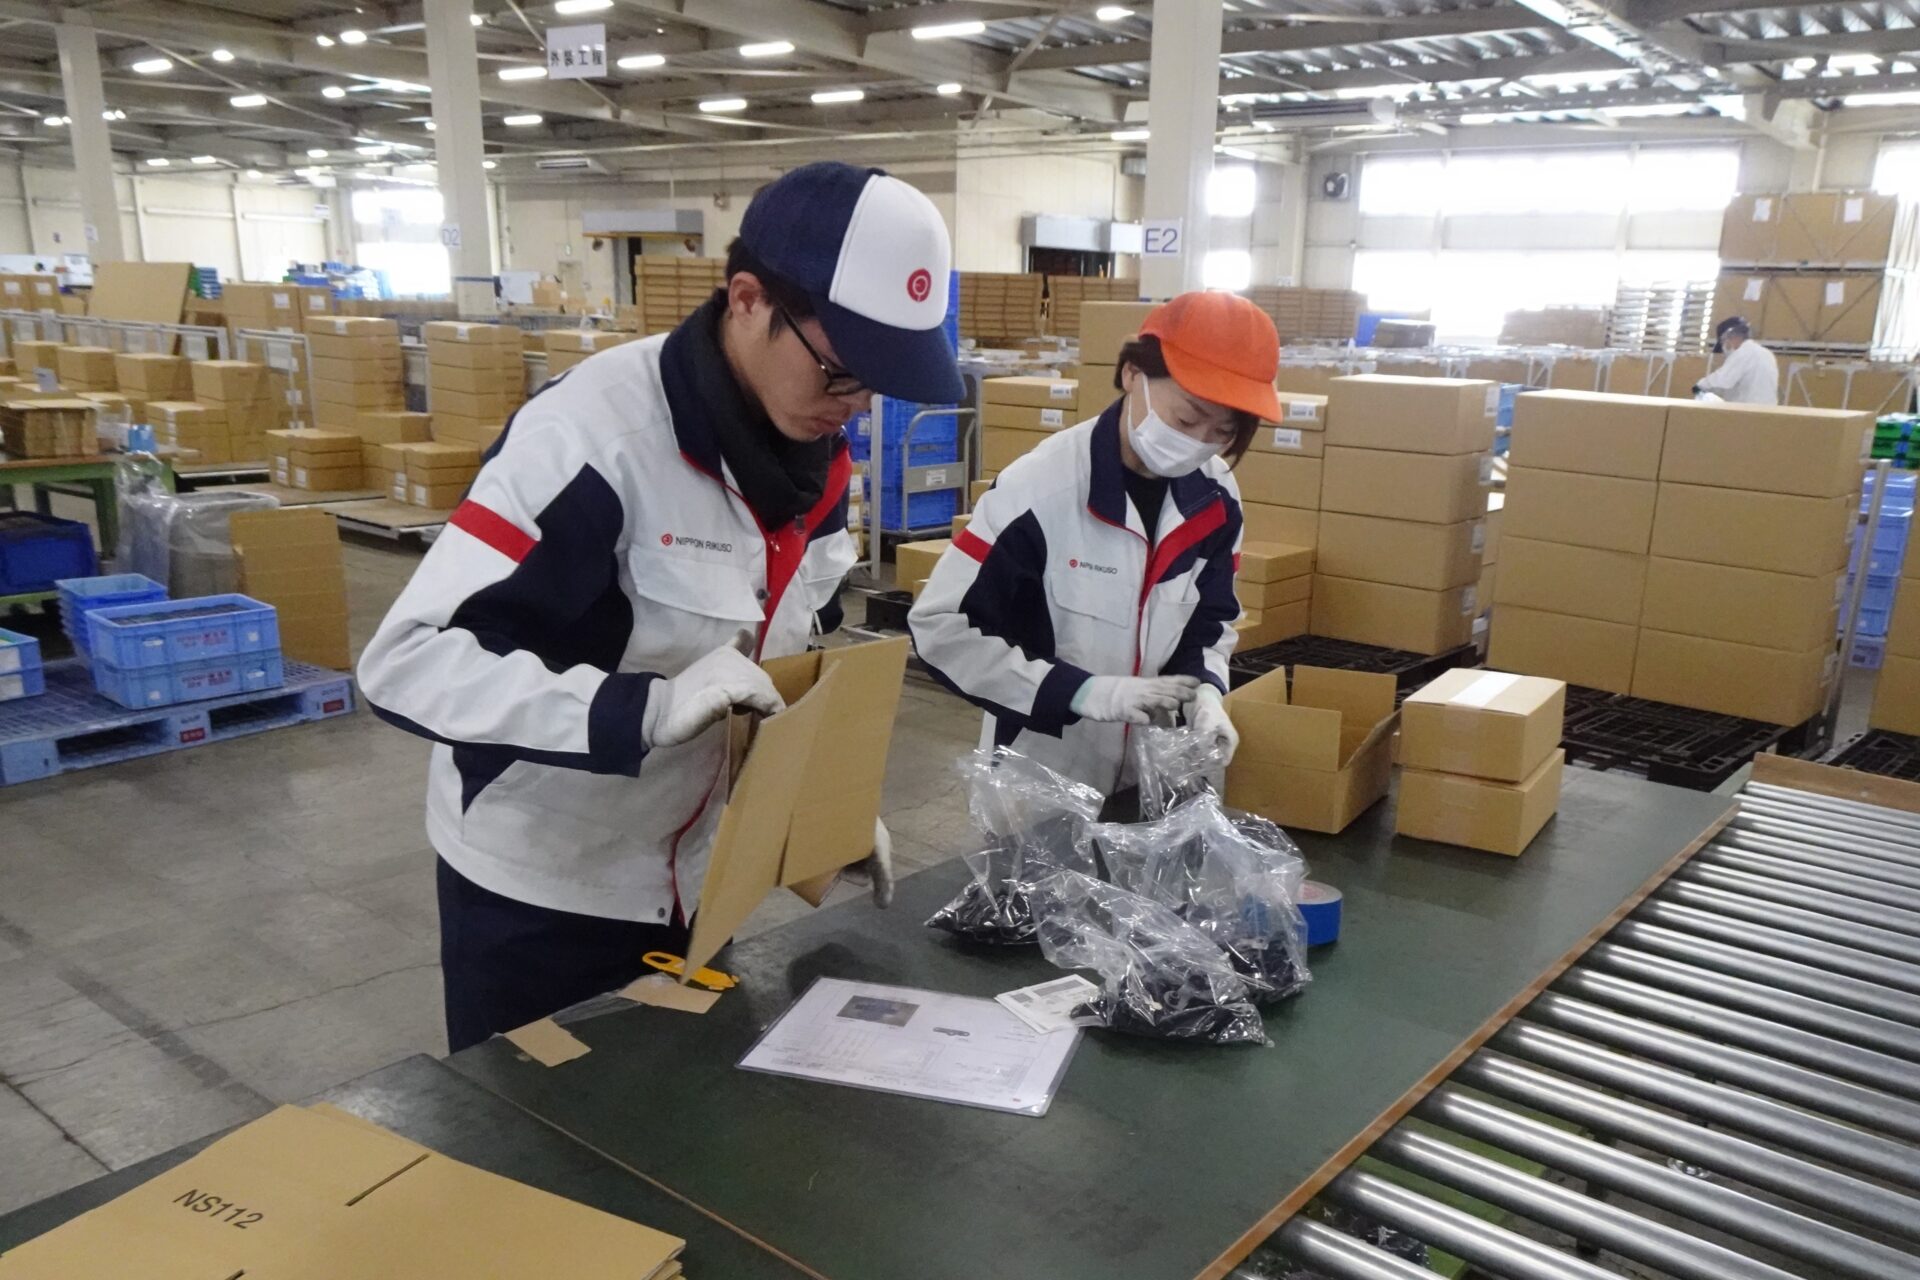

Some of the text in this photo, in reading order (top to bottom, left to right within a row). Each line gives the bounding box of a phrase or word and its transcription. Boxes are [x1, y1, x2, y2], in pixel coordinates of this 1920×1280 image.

[1145, 228, 1178, 253] E2
[675, 536, 733, 553] NIPPON RIKUSO
[172, 1188, 264, 1230] NS112
